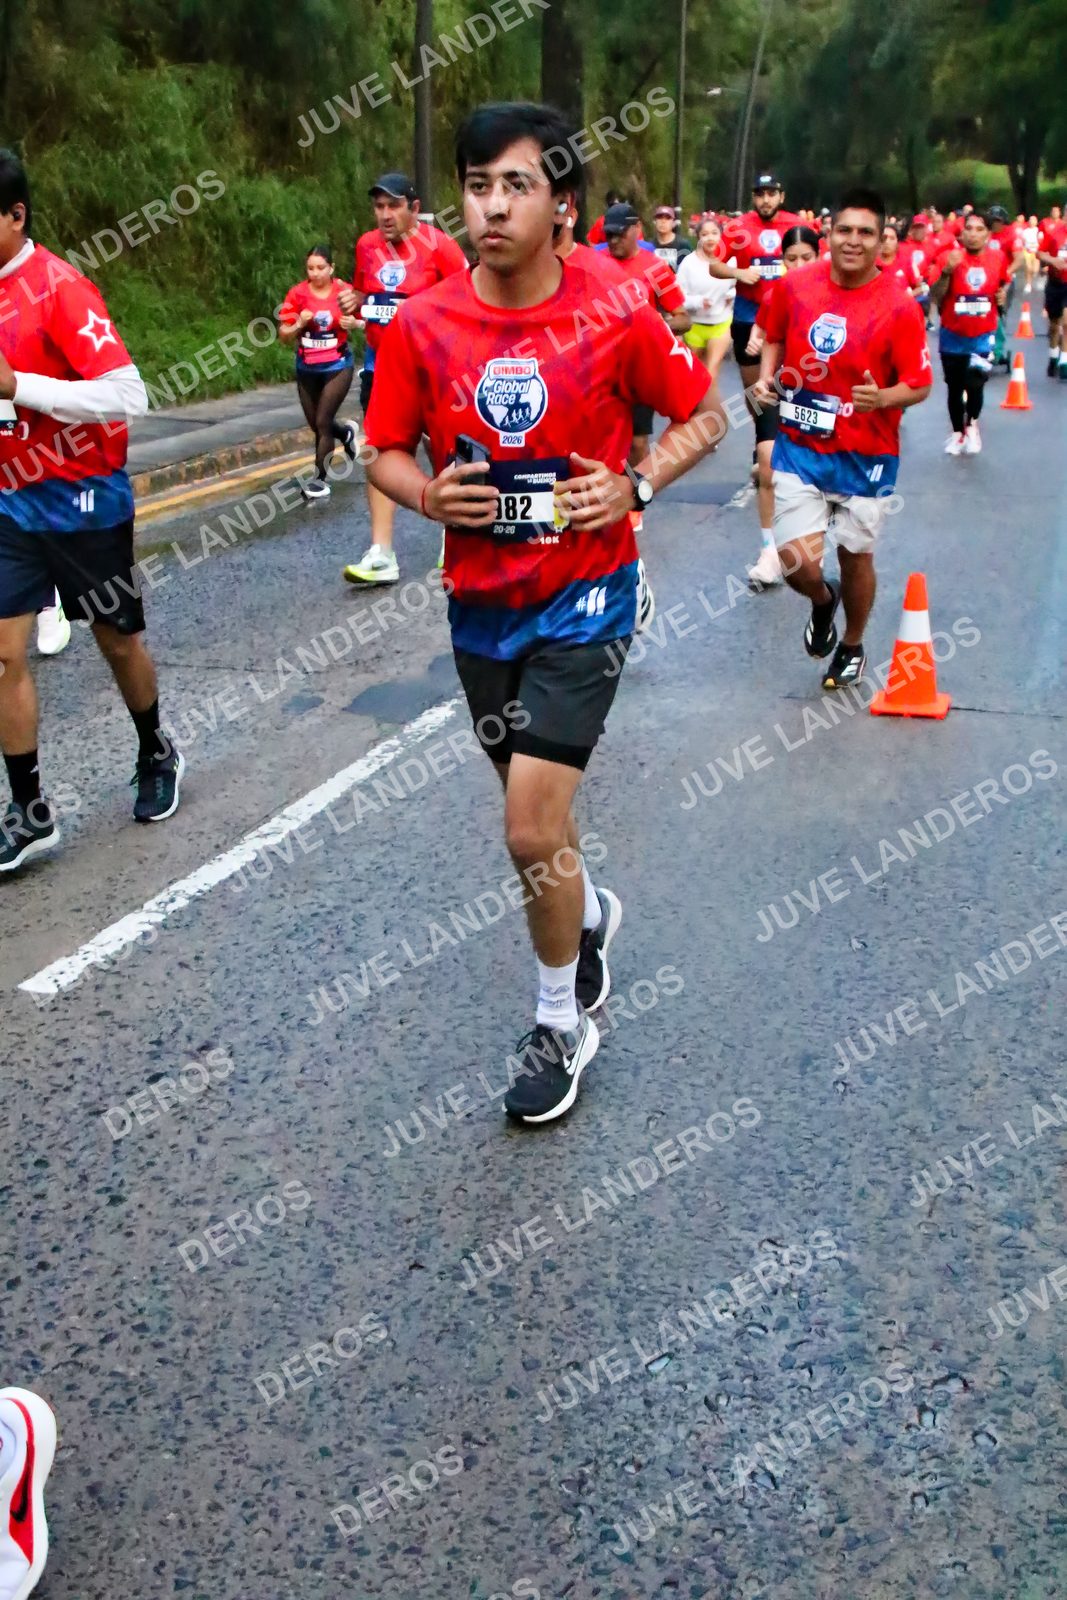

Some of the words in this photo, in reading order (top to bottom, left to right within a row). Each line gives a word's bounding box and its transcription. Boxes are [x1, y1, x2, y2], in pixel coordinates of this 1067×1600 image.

[375, 306, 395, 318] 4246
[494, 380, 530, 393] Global
[487, 392, 516, 405] Race
[794, 406, 819, 425] 5623
[502, 435, 523, 445] 2026
[540, 536, 560, 545] 10K
